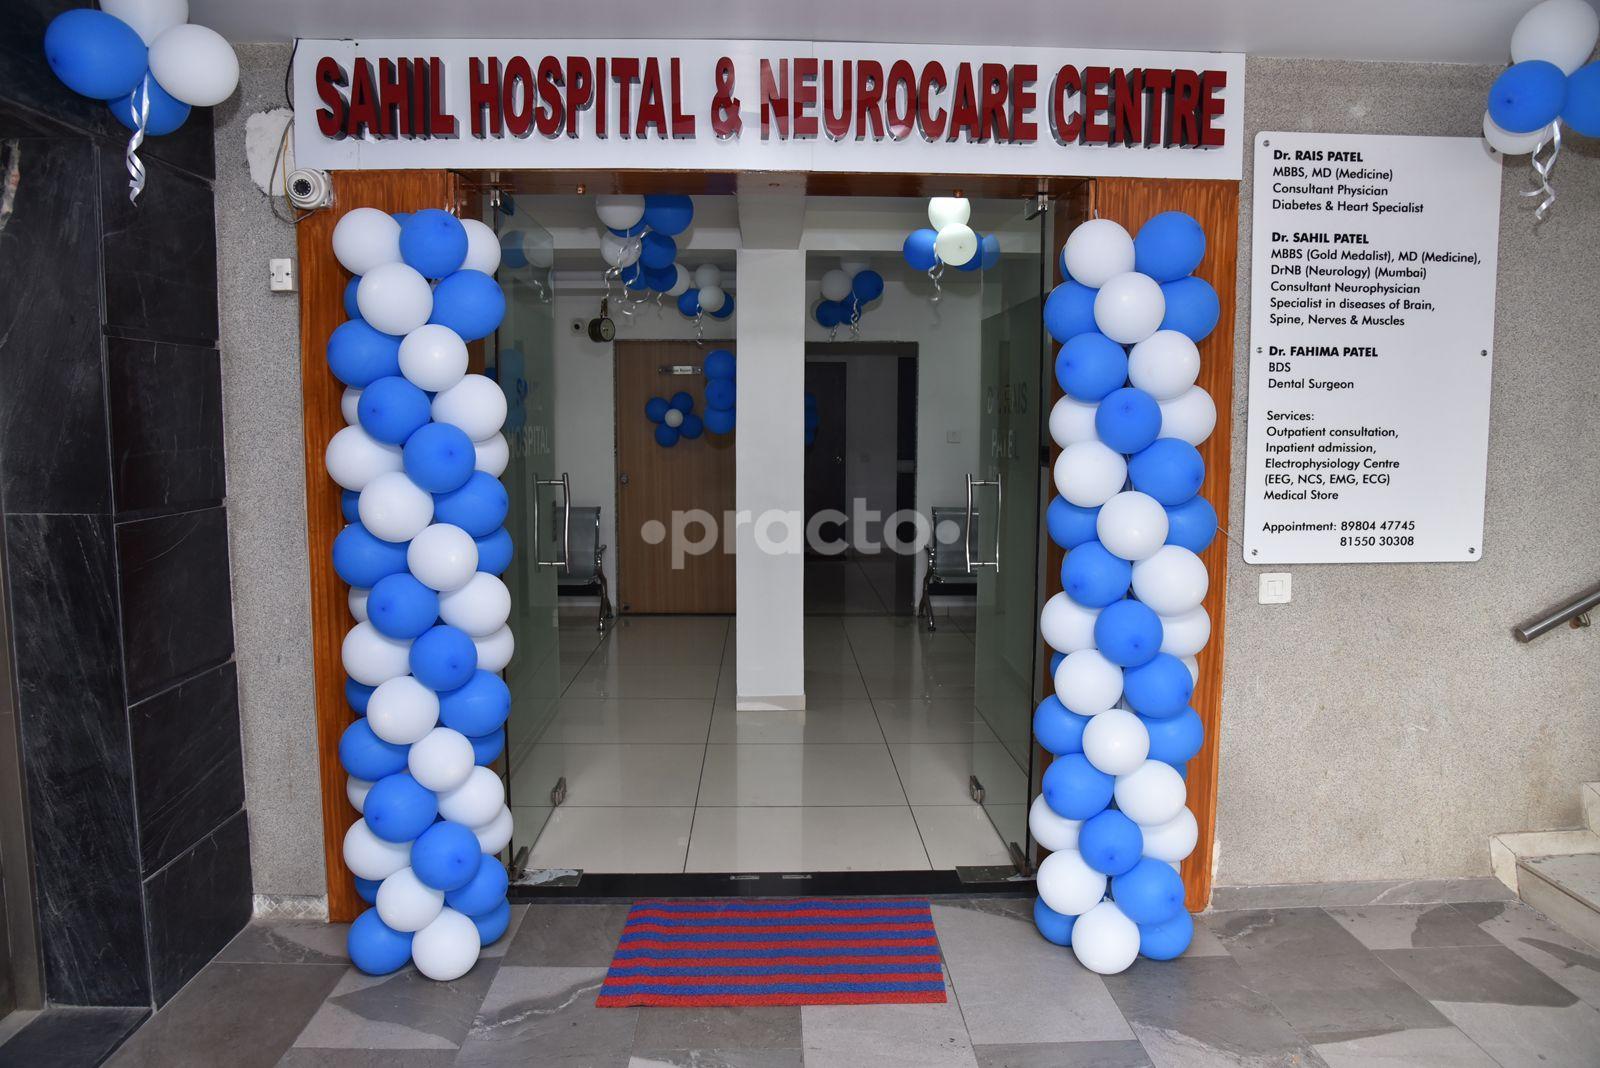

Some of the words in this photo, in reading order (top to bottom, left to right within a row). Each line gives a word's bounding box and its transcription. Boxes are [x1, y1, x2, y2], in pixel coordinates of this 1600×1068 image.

[315, 55, 460, 140] SAHIL
[468, 55, 696, 140] HOSPITAL
[711, 56, 742, 140] &
[760, 58, 1038, 145] NEUROCARE
[1048, 64, 1227, 150] CENTRE
[1273, 149, 1292, 161] Dr.
[1294, 149, 1324, 162] RAIS
[1327, 150, 1364, 163] PATEL
[1272, 166, 1308, 180] MBBS,
[1311, 167, 1332, 179] MD
[1335, 167, 1393, 183] (Medicine)
[1272, 182, 1334, 195] Consultant
[1337, 184, 1389, 198] Physician
[1272, 198, 1322, 211] Diabetes
[1324, 200, 1334, 211] &
[1337, 200, 1369, 212] Heart
[1371, 201, 1424, 215] Specialist
[1271, 231, 1289, 243] Dr.
[1292, 232, 1331, 244] SAHIL
[1333, 233, 1370, 245] PATEL
[1270, 248, 1303, 260] MBBS
[1306, 248, 1338, 262] (Gold
[1340, 249, 1395, 264] Medalist),
[1397, 250, 1418, 262] MD
[1421, 250, 1481, 266] (Medicine),
[1270, 264, 1302, 276] DrNB
[1305, 265, 1371, 280] (Neurology)
[1374, 266, 1427, 281] (Mumbai)
[1270, 280, 1332, 293] Consultant
[1334, 282, 1421, 297] Neurophysician
[1269, 296, 1323, 310] Specialist
[1325, 297, 1336, 309] in
[1339, 297, 1386, 310] diseases
[1388, 298, 1401, 310] of
[1403, 299, 1435, 312] Brain,
[1269, 313, 1305, 327] Spine,
[1308, 313, 1347, 325] Nerves
[1349, 314, 1359, 326] &
[1361, 314, 1406, 326] Muscles
[1268, 345, 1286, 357] Dr.
[1290, 345, 1340, 357] FAHIMA
[1342, 346, 1379, 358] PATEL
[1268, 361, 1292, 373] BDS
[1268, 378, 1305, 389] Dental
[1308, 378, 1355, 392] Surgeon
[1266, 410, 1315, 421] Services:
[1266, 426, 1327, 439] Outpatient
[1328, 426, 1399, 439] consultation,
[1265, 442, 1315, 455] Inpatient
[1317, 441, 1377, 455] admission,
[1265, 457, 1361, 471] Electrophysiology
[1363, 458, 1400, 469] Centre
[1264, 473, 1294, 487] (EEG,
[1297, 473, 1326, 486] NCS,
[1329, 473, 1359, 486] EMG,
[1362, 473, 1391, 487] ECG)
[1263, 489, 1307, 501] Medical
[1310, 489, 1339, 500] Store
[1262, 521, 1337, 534] Appointment:
[1340, 520, 1376, 532] 89804
[1379, 520, 1416, 531] 47745
[1339, 536, 1376, 547] 81550
[1378, 535, 1415, 547] 30308
